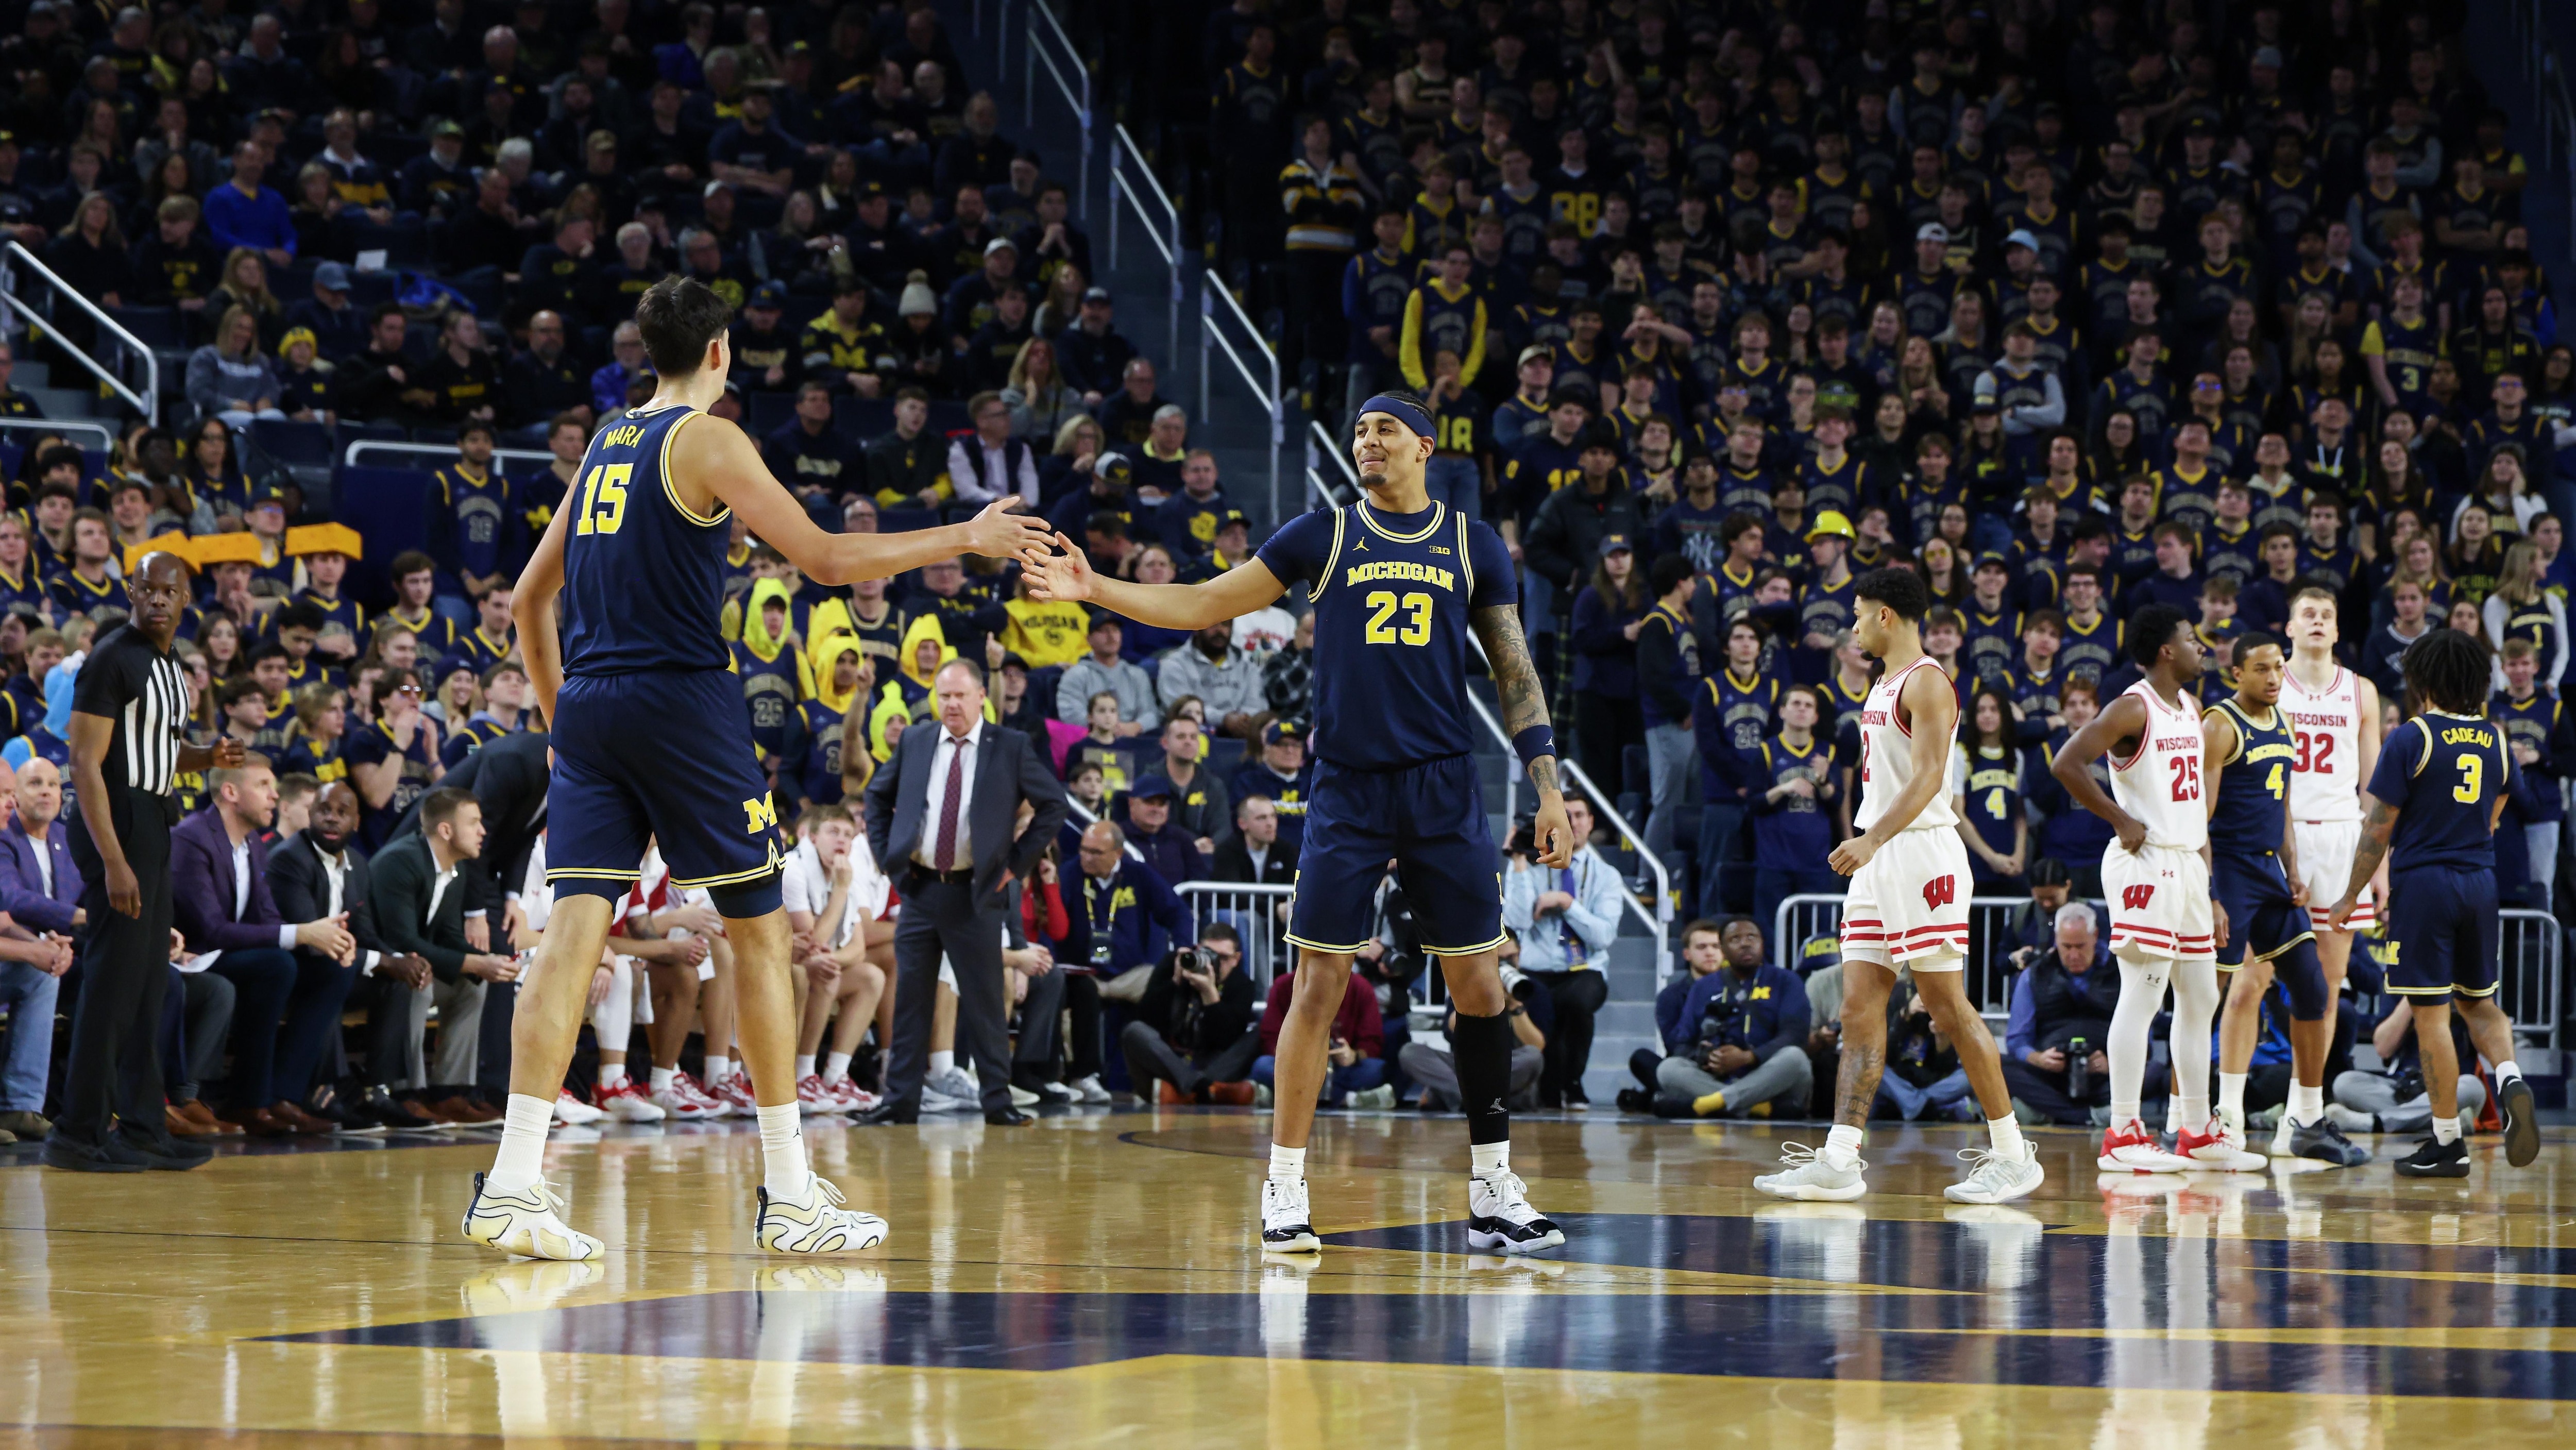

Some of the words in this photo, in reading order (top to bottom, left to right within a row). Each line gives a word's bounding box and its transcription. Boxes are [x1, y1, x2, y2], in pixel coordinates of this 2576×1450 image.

[2400, 366, 2419, 392] 3
[602, 425, 646, 450] MARA
[577, 463, 634, 536] 15
[1347, 561, 1454, 593] MICHIGAN
[1365, 591, 1434, 647] 23
[2287, 713, 2347, 727] ISCONSIN
[2292, 732, 2334, 773] 32
[2441, 727, 2493, 749] CADEAU
[2170, 755, 2198, 802] 25
[2265, 763, 2284, 800] 4
[2452, 753, 2483, 804] 3
[742, 790, 778, 835] M
[1985, 787, 2007, 820] 4
[1923, 874, 1955, 912] W
[2122, 884, 2155, 912] W
[1751, 986, 1772, 1000] M
